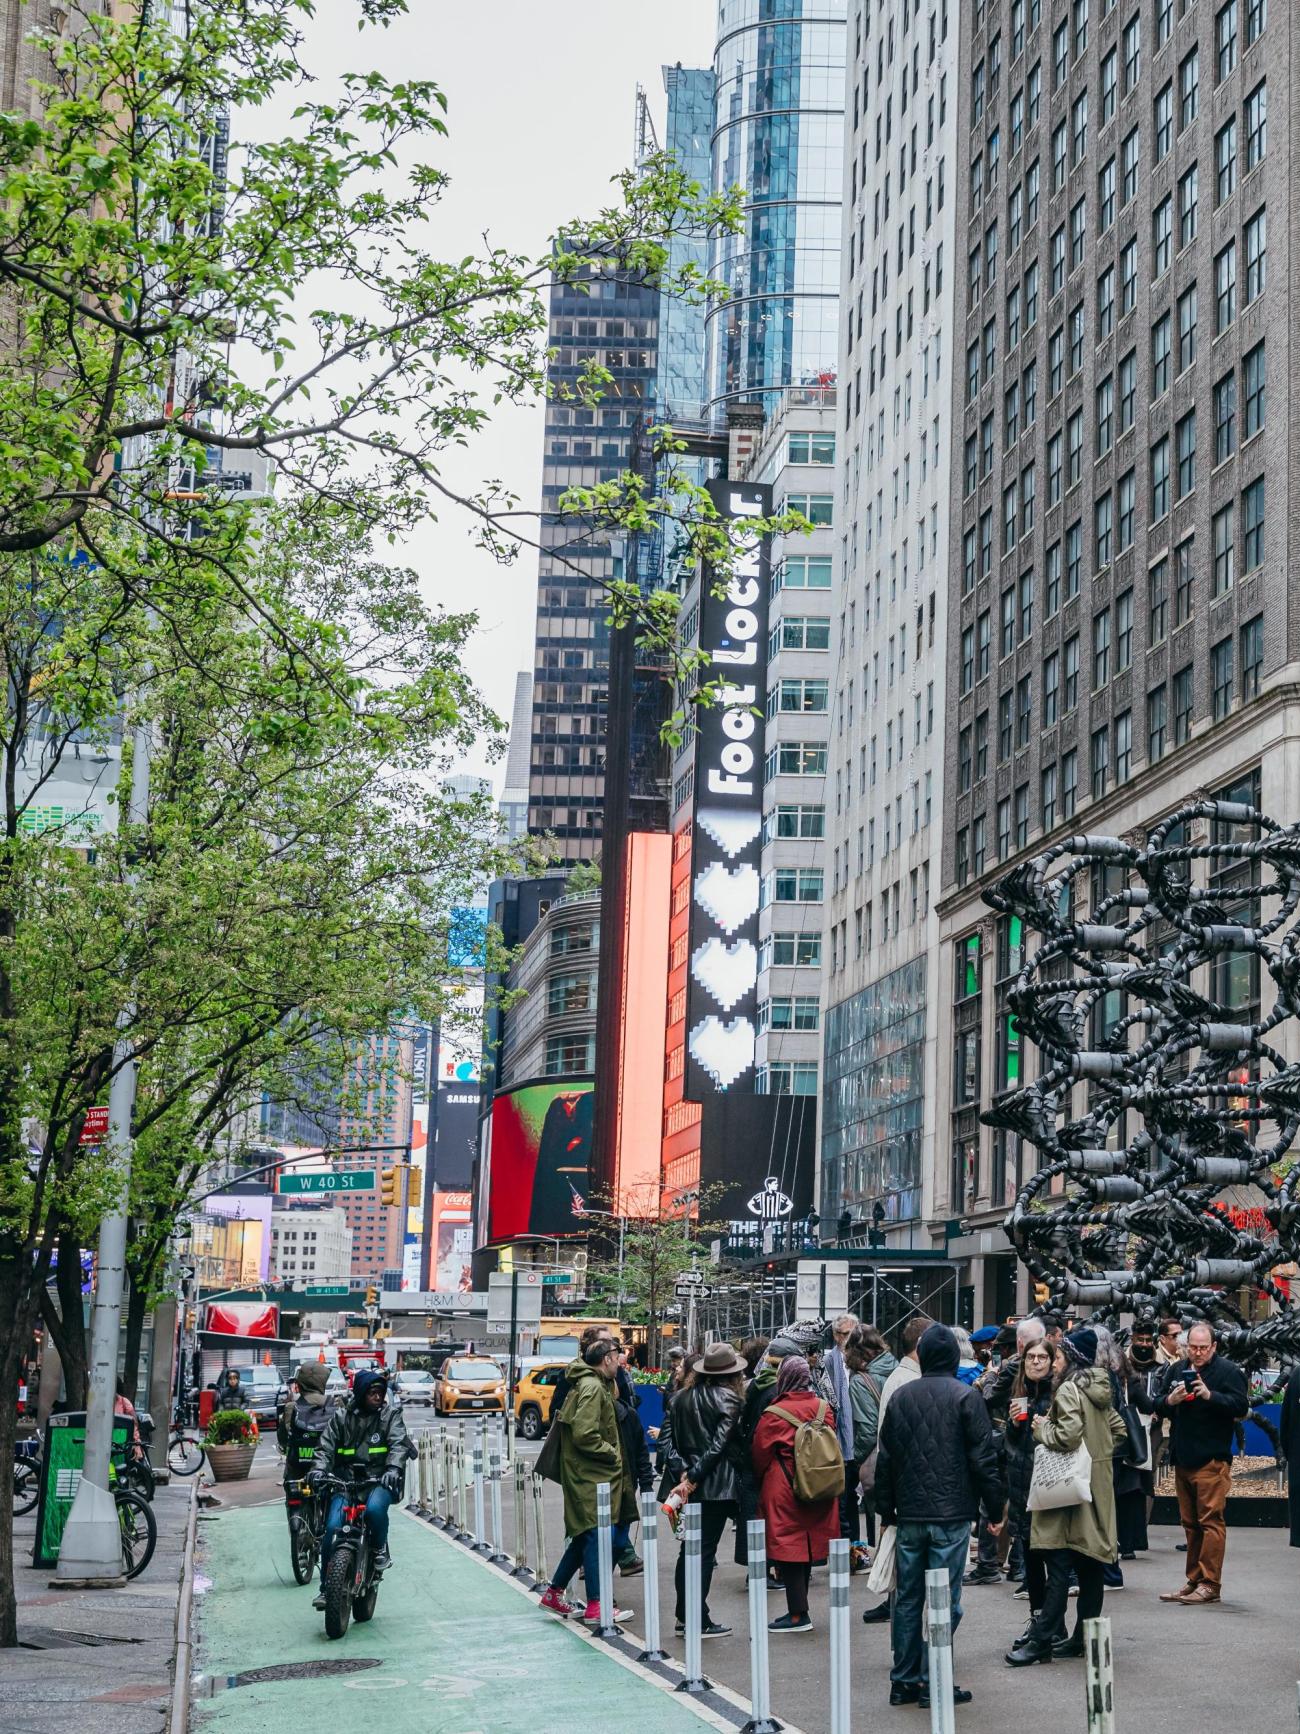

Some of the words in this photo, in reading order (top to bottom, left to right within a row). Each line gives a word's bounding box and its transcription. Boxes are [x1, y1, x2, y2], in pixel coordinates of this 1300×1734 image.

[712, 493, 763, 665] Locker
[708, 684, 756, 796] Foot
[300, 1177, 312, 1190] W
[318, 1176, 335, 1189] 40
[341, 1175, 355, 1188] St
[424, 1294, 454, 1306] H&M
